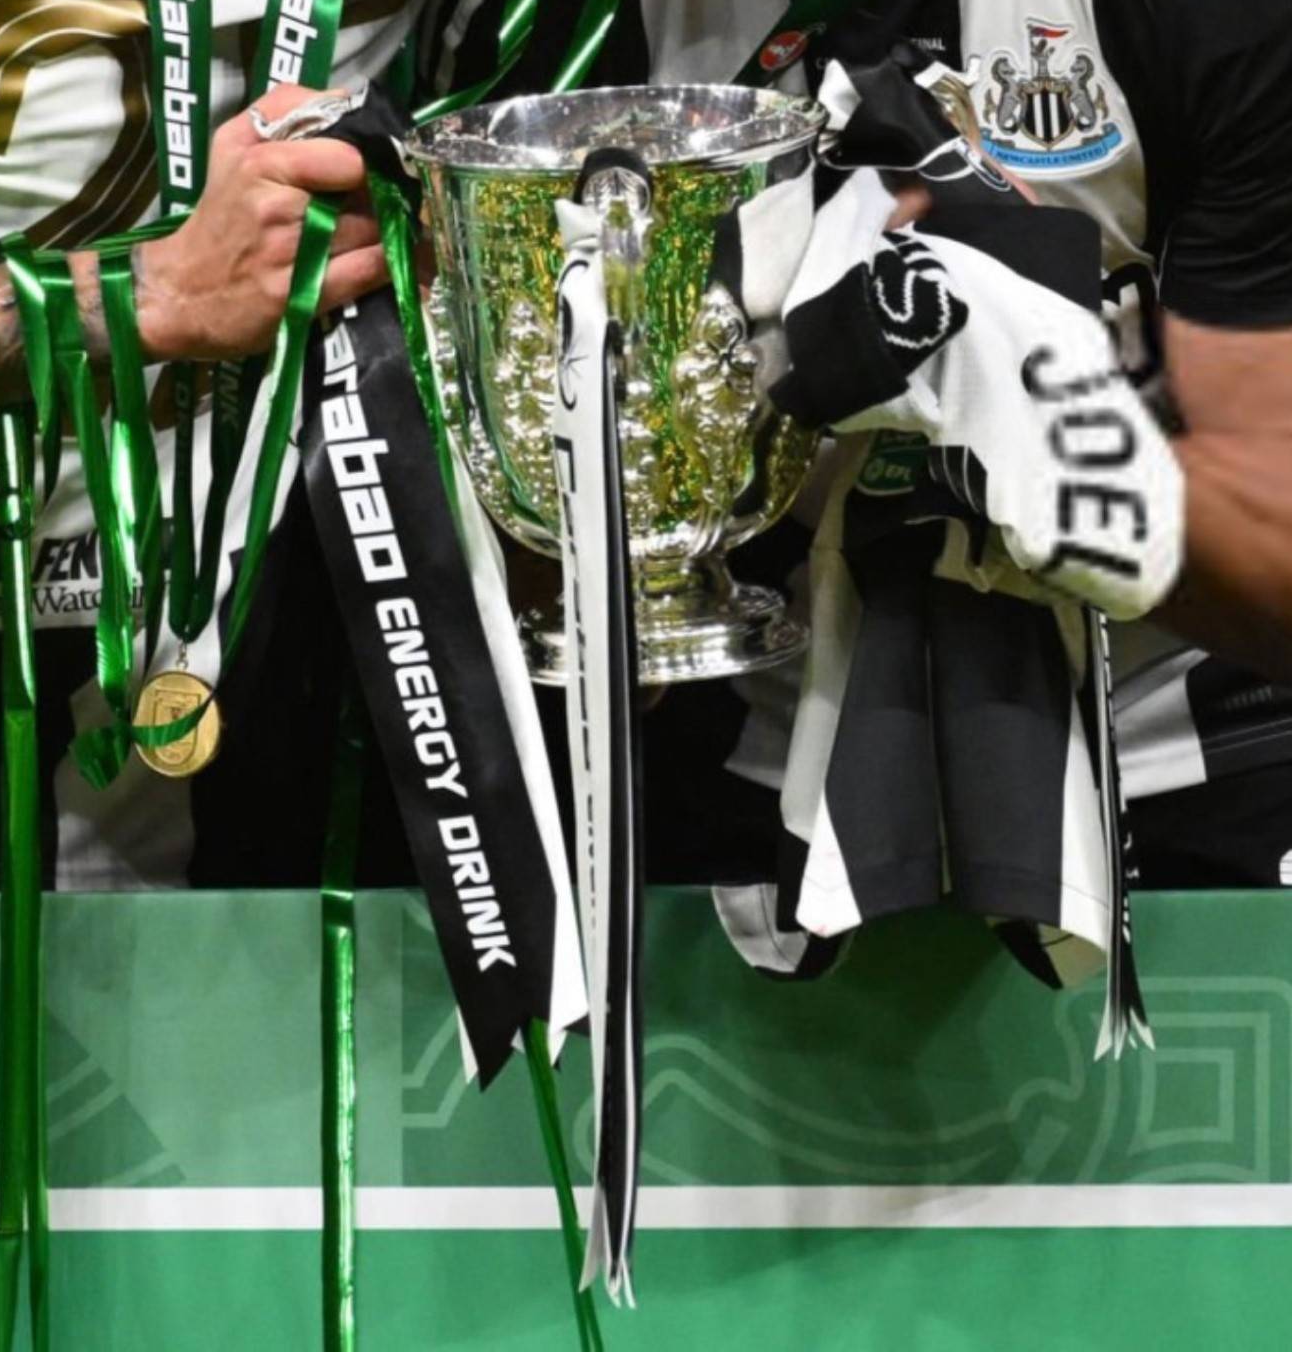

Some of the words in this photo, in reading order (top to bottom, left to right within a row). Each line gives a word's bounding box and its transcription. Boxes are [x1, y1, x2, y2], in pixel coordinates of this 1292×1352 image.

[32, 532, 100, 584] FEN
[320, 303, 408, 584] arabao
[375, 597, 469, 799] ENERGY
[437, 814, 518, 973] DRINK
